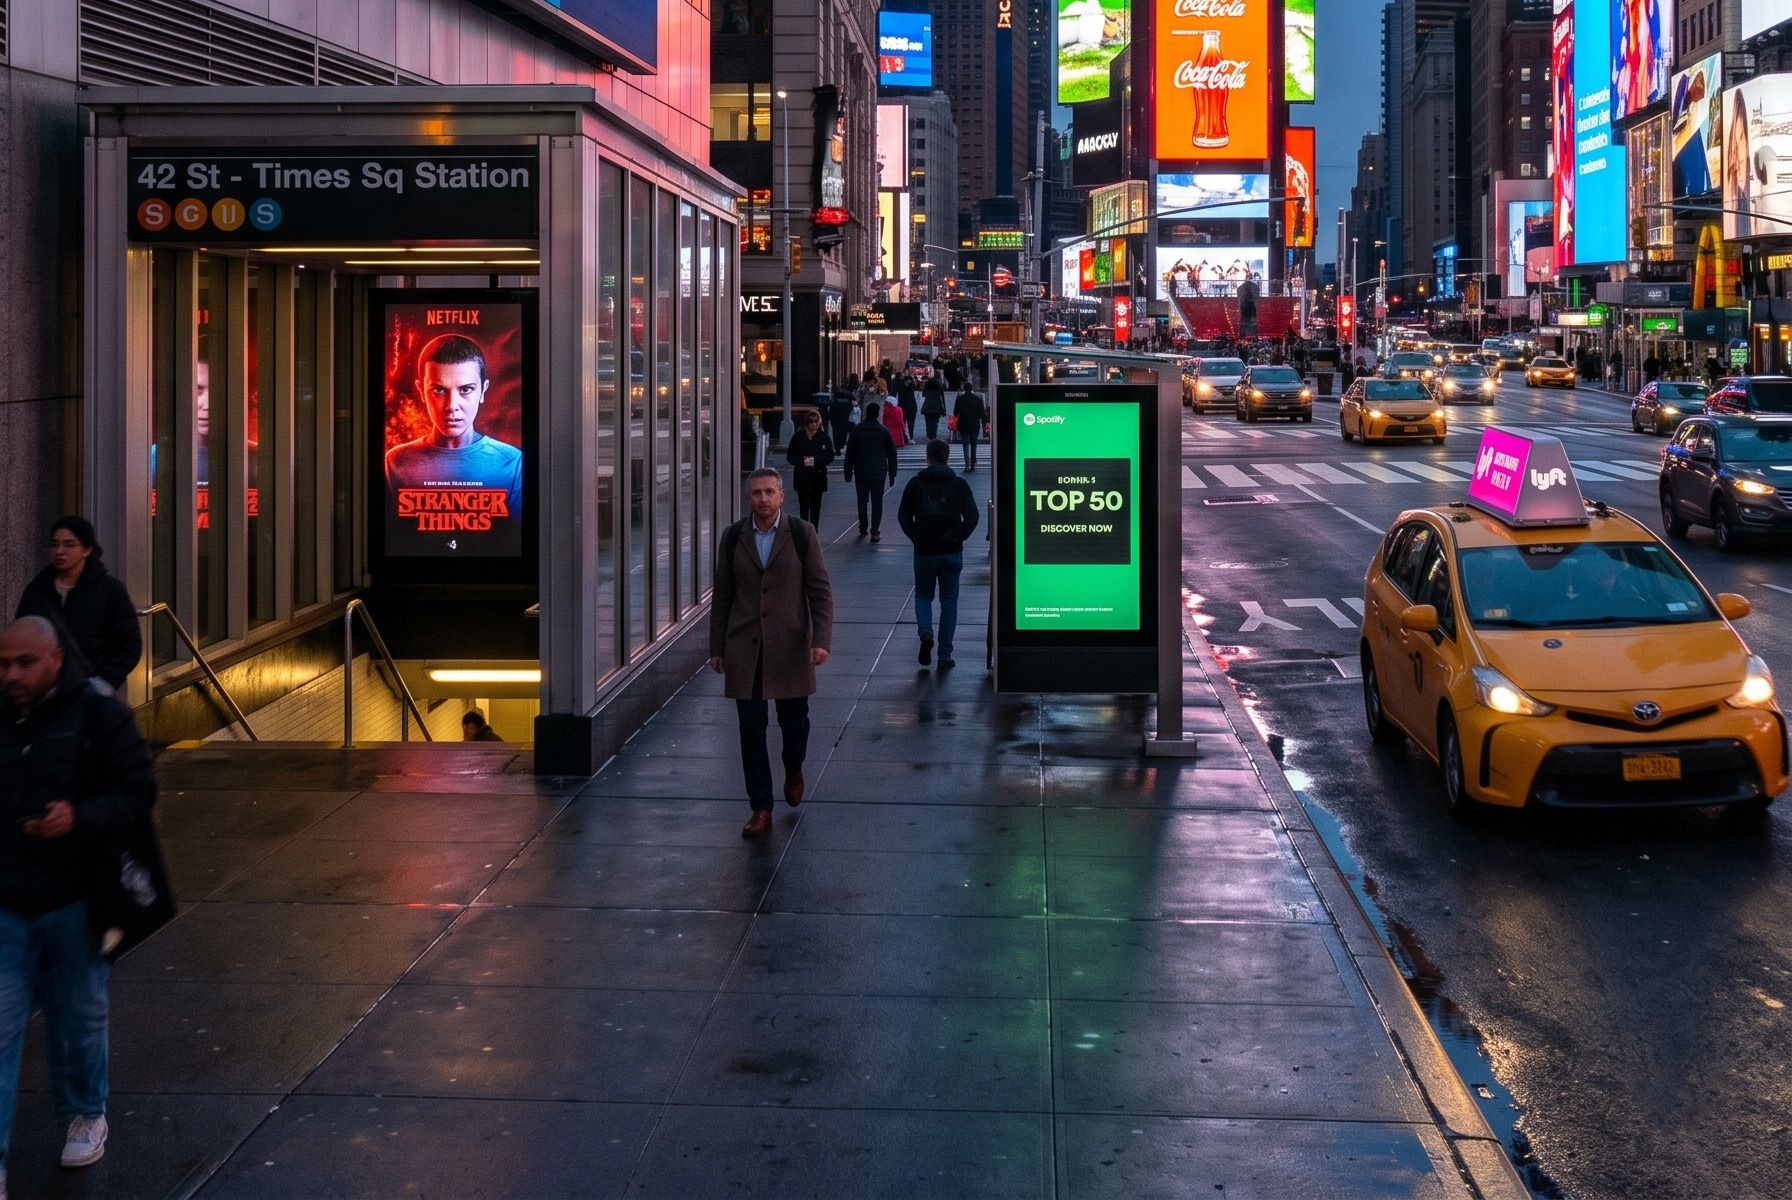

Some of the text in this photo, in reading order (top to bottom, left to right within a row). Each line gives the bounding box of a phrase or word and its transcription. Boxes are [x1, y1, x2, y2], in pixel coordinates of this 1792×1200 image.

[138, 163, 176, 189] 42
[186, 162, 221, 189] St
[252, 162, 351, 189] Times
[361, 161, 404, 194] Sq
[415, 161, 529, 189] Station
[427, 310, 480, 326] NETFLIX
[1036, 415, 1065, 425] Spotify
[1530, 467, 1568, 491] lyft
[398, 490, 509, 515] STRANGER
[1030, 490, 1123, 511] TOP 50
[415, 512, 492, 531] THINGS
[1040, 524, 1113, 533] DISCOVER NOW
